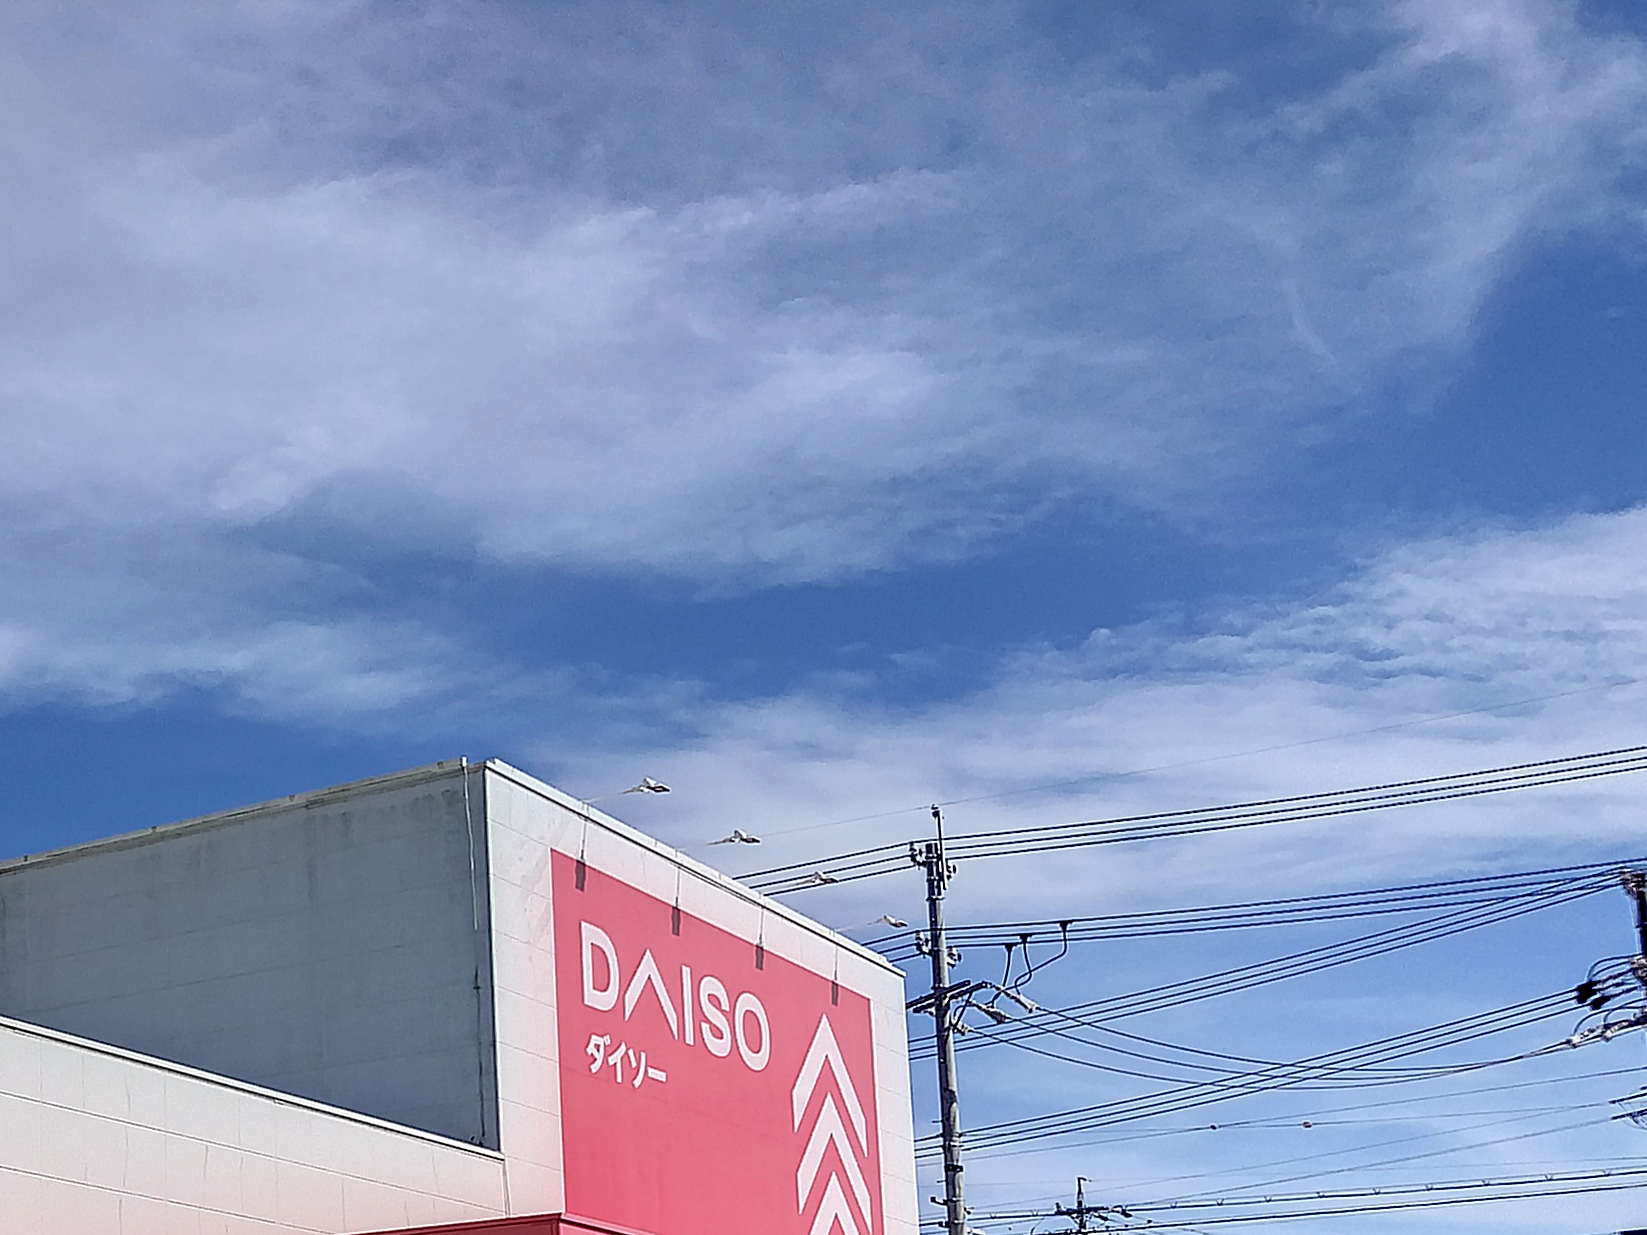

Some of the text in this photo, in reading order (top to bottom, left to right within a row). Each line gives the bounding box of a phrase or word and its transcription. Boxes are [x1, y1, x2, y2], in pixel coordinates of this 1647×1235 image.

[580, 920, 772, 1072] DAISO
[585, 1033, 668, 1089] ダイソー
